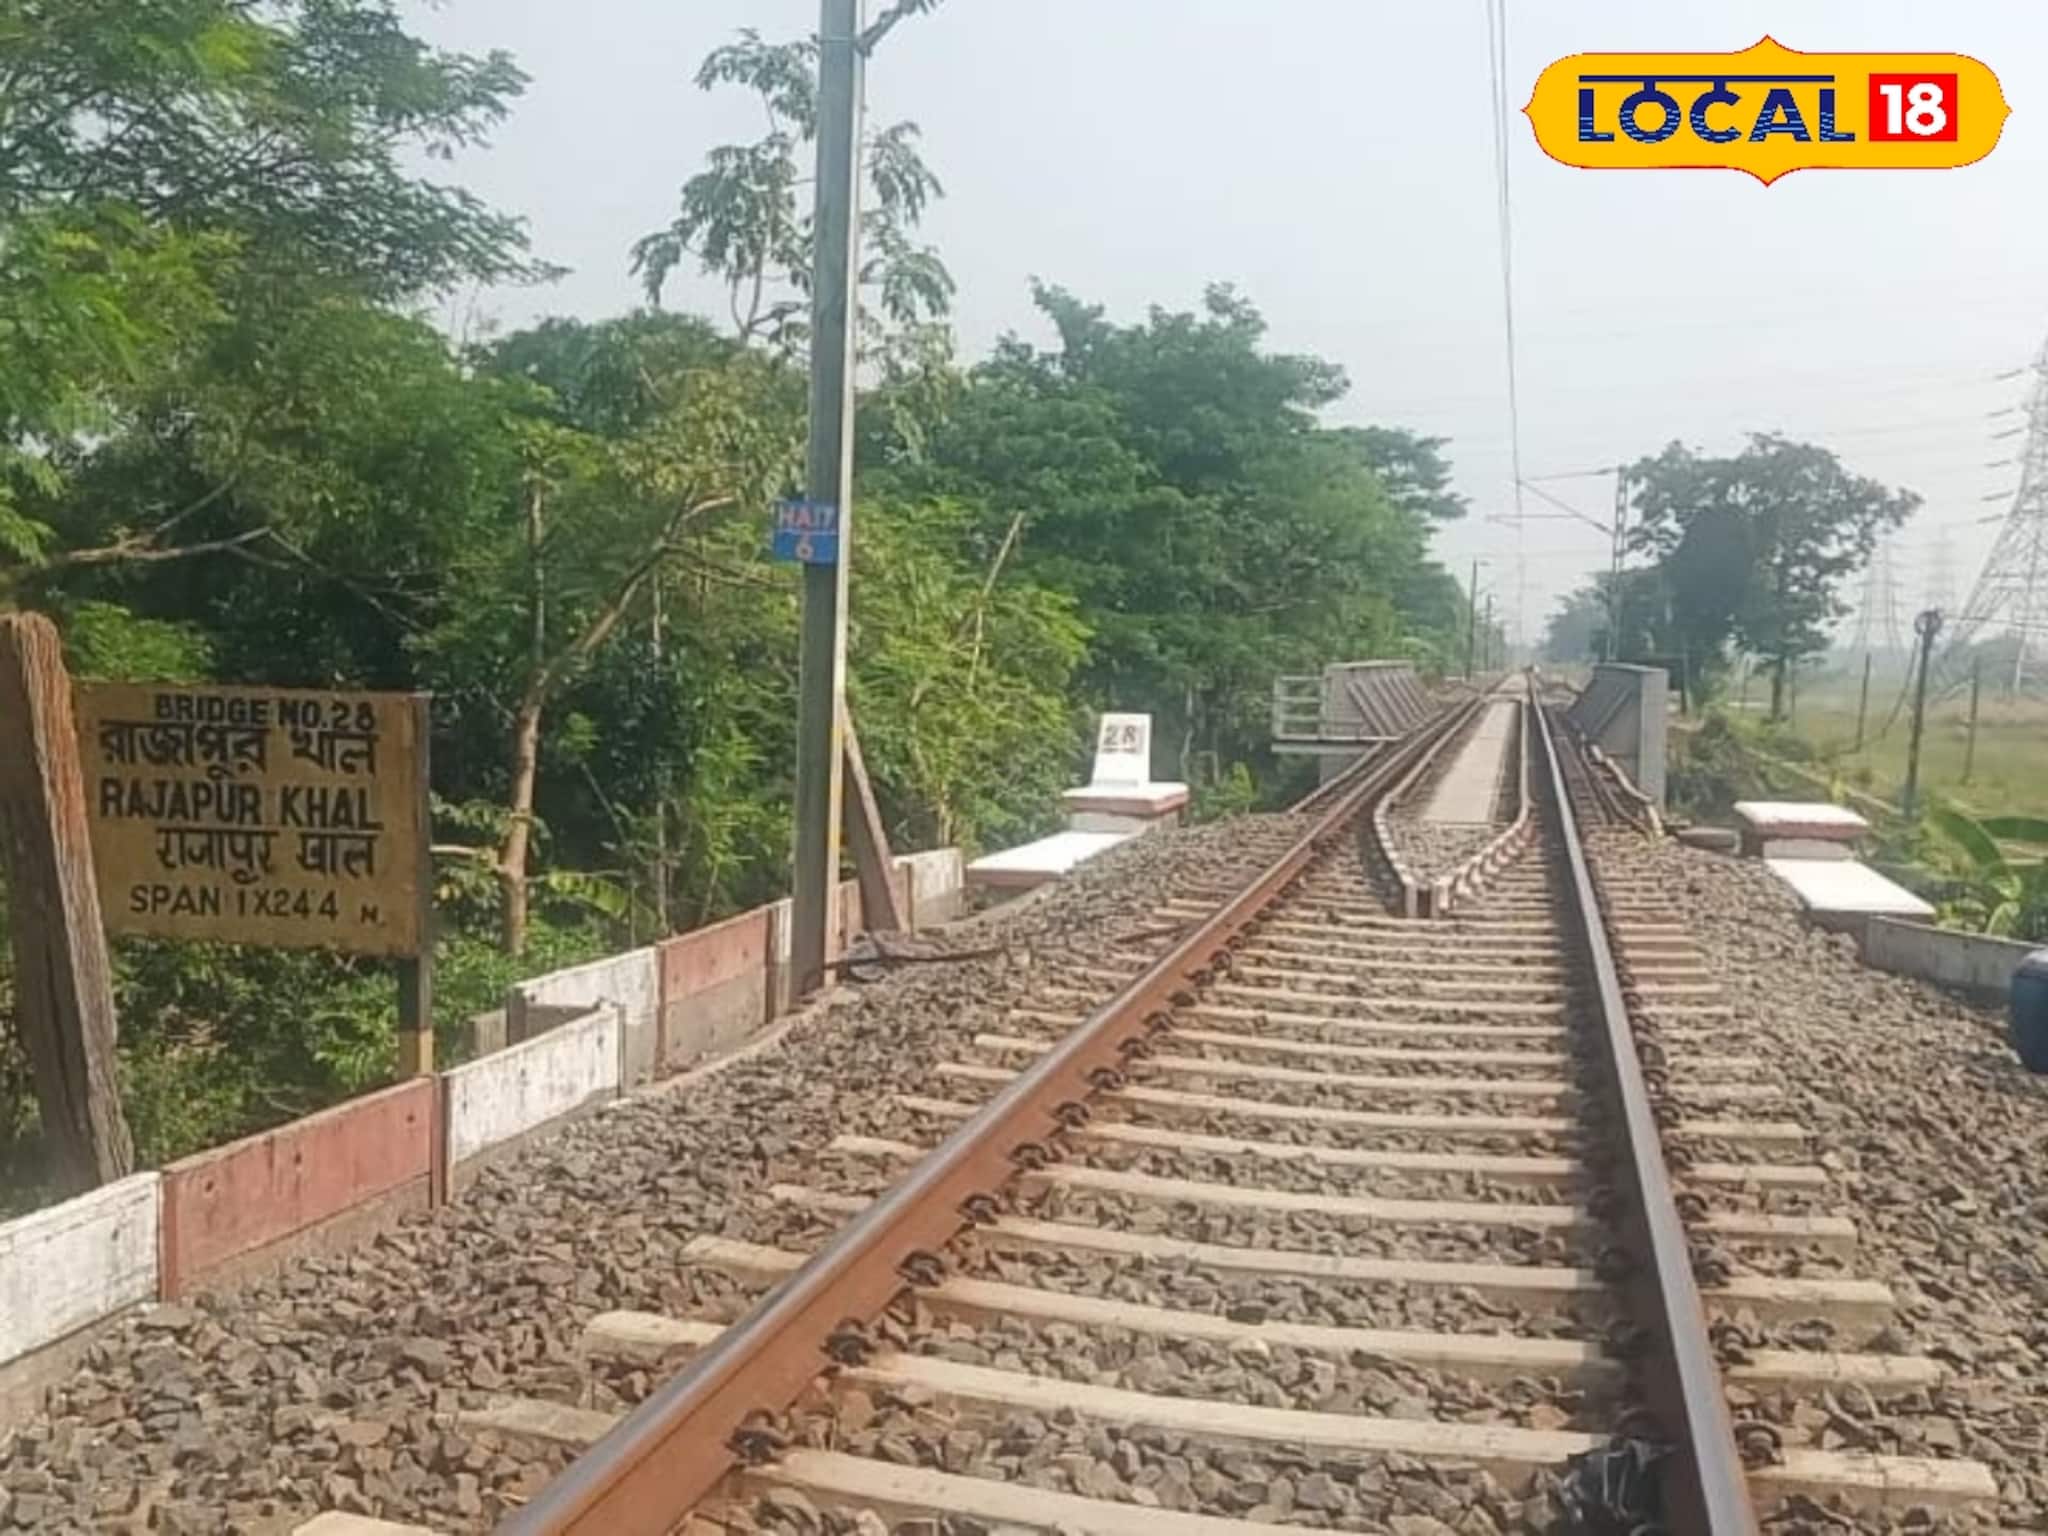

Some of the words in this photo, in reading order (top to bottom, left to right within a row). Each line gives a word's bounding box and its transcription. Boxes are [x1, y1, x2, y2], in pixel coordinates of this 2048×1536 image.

[796, 531, 814, 560] 6
[156, 694, 269, 724] BRIDGE
[1103, 724, 1137, 748] 28
[99, 777, 262, 825] RAJAPUR
[280, 785, 384, 831] KHAL
[130, 884, 220, 916] SPAN
